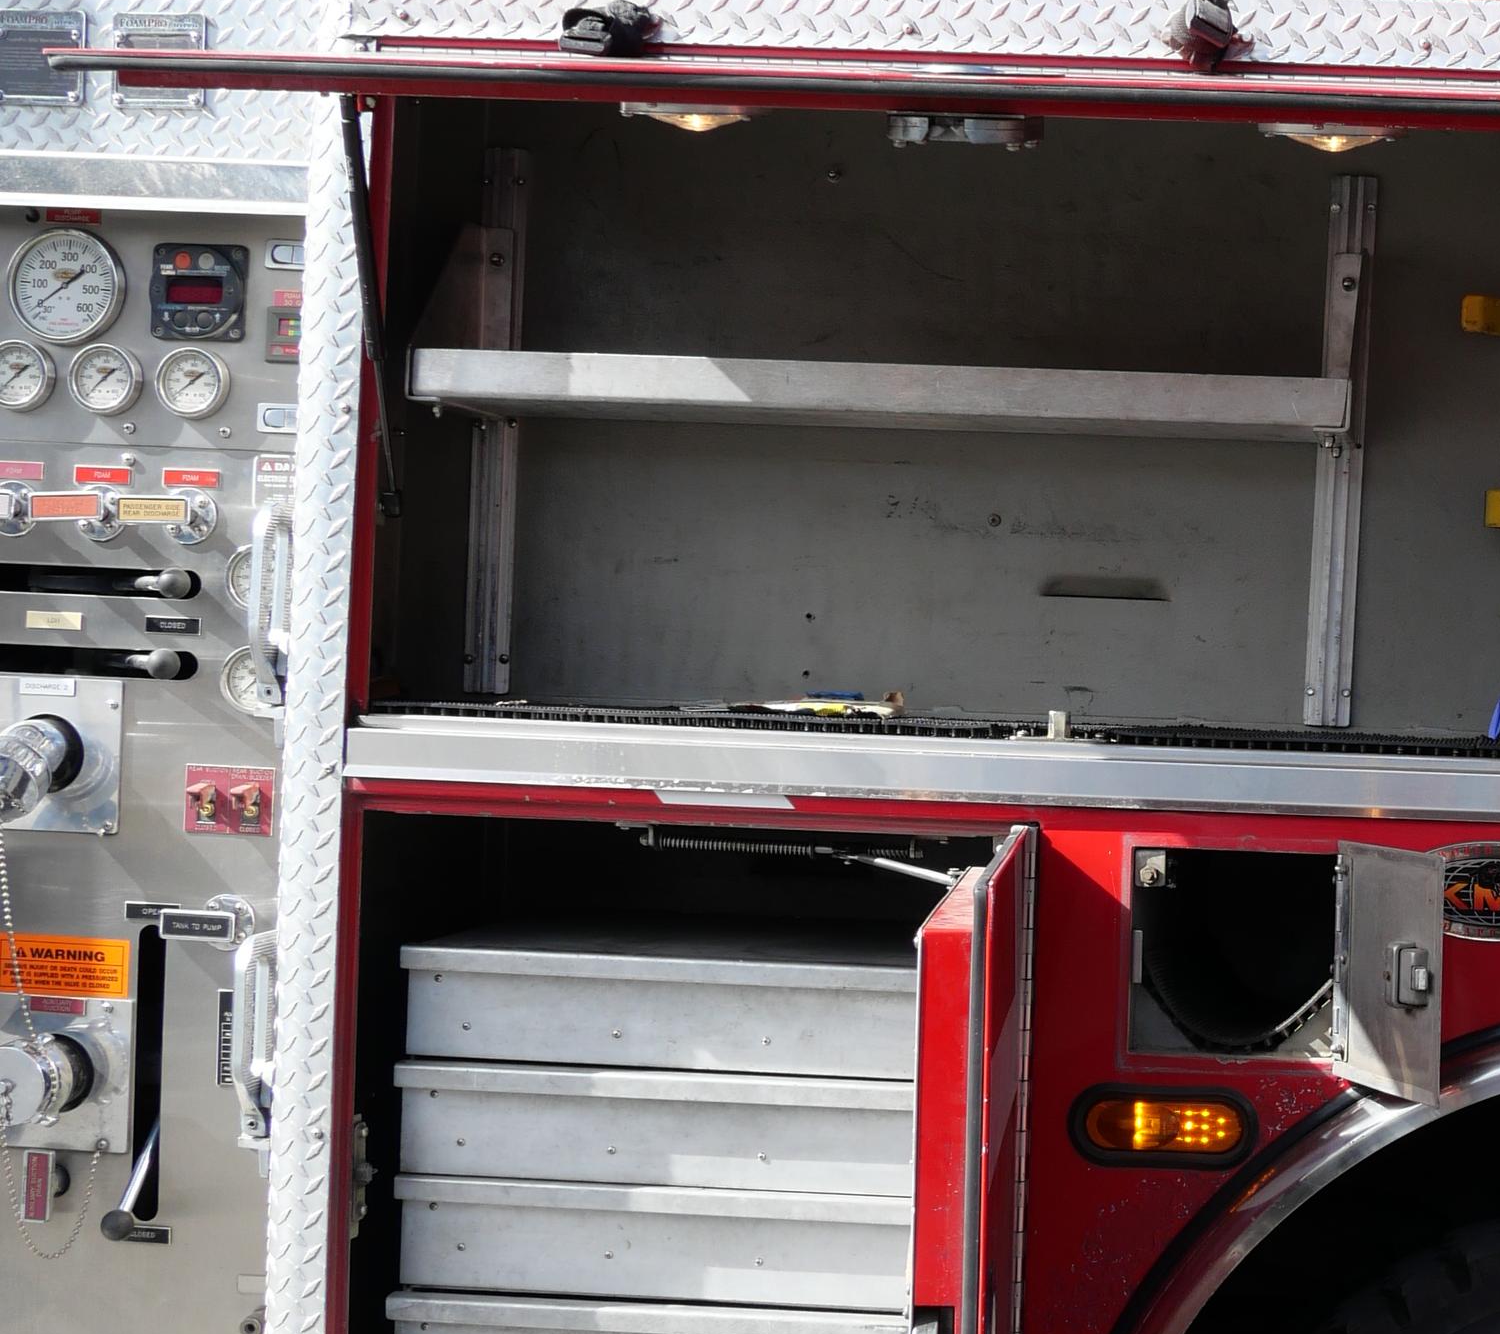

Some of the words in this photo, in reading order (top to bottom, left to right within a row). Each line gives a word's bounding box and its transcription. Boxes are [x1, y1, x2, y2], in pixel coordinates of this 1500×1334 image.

[61, 252, 79, 262] 300
[39, 260, 57, 270] 200
[32, 279, 48, 288] 100
[82, 284, 99, 294] 500
[76, 303, 93, 313] 600
[160, 621, 186, 629] CLOSED
[172, 921, 189, 929] TANK
[30, 948, 105, 962] WARNING
